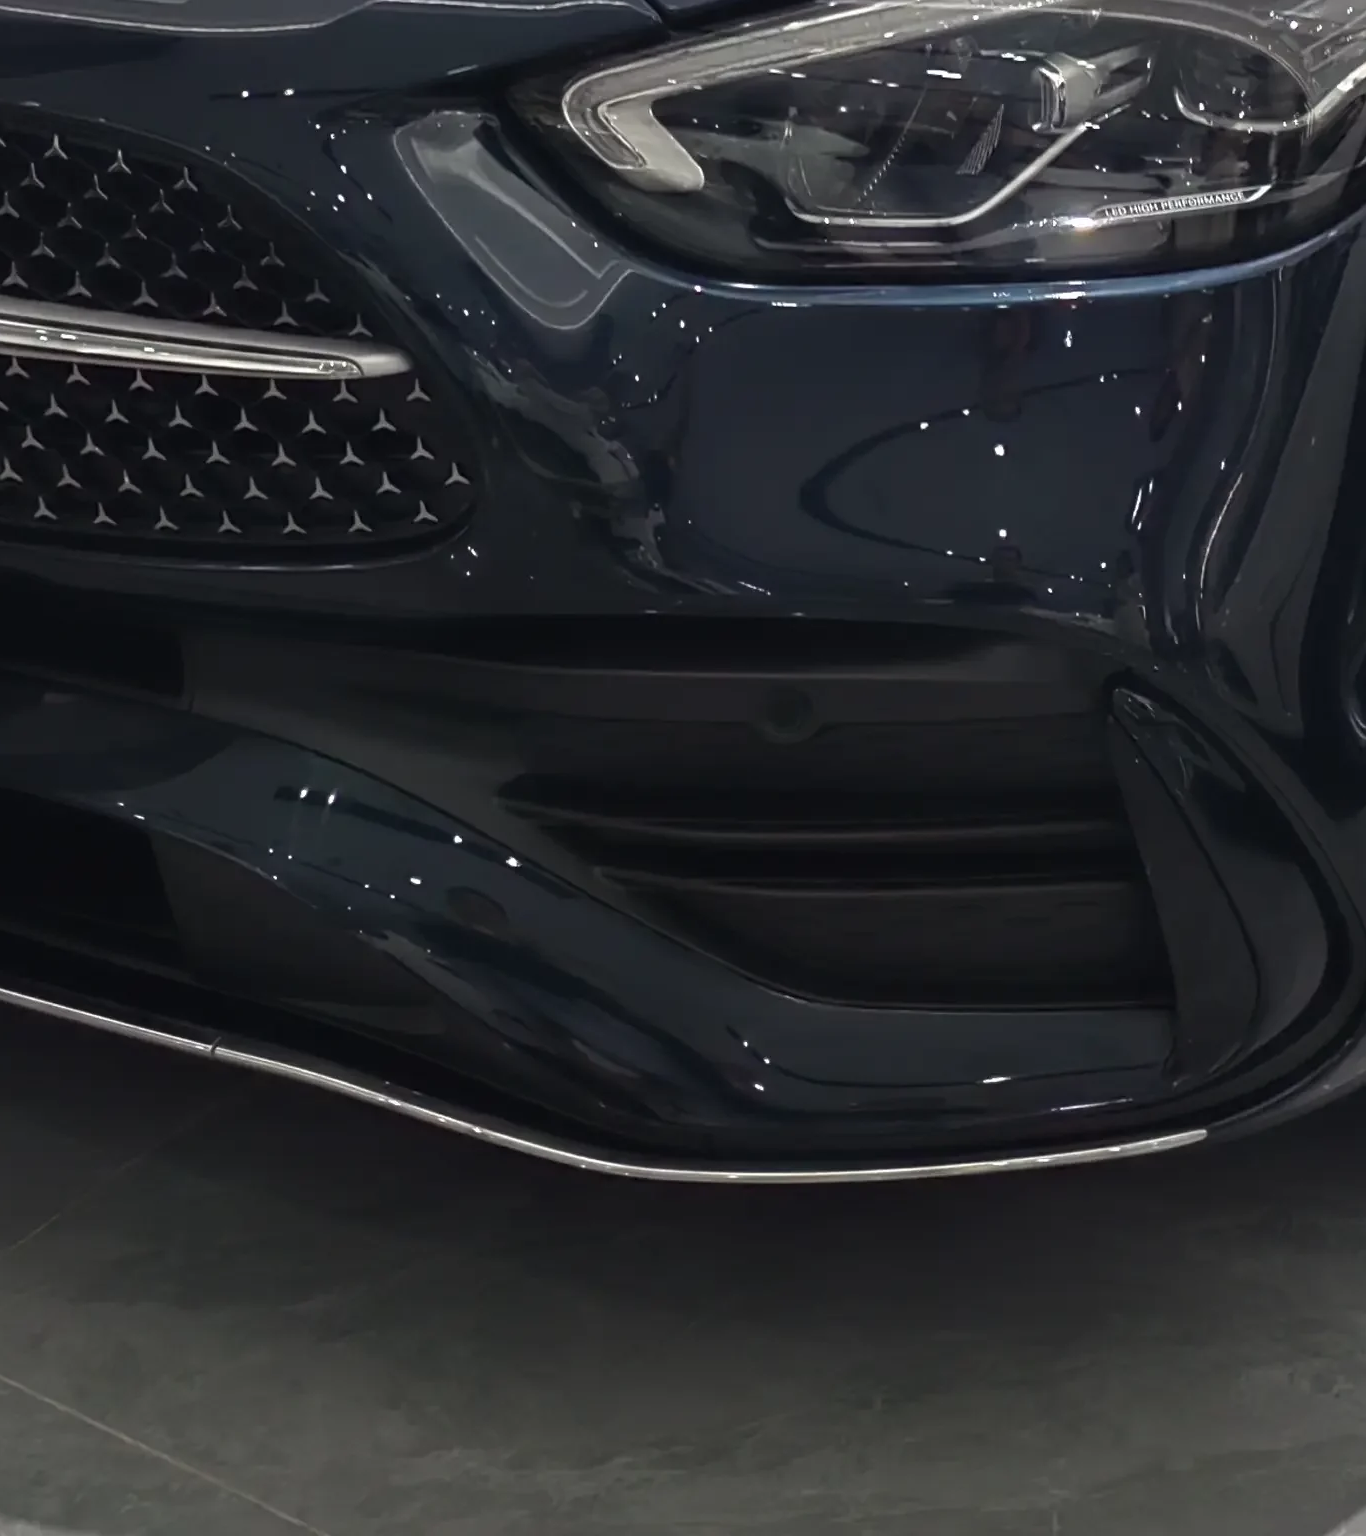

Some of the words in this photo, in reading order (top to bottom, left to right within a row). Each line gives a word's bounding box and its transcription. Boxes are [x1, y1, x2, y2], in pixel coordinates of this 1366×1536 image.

[1104, 207, 1128, 218] LED
[1129, 201, 1158, 215] HIGH
[1161, 190, 1245, 211] PERFORMANCE
